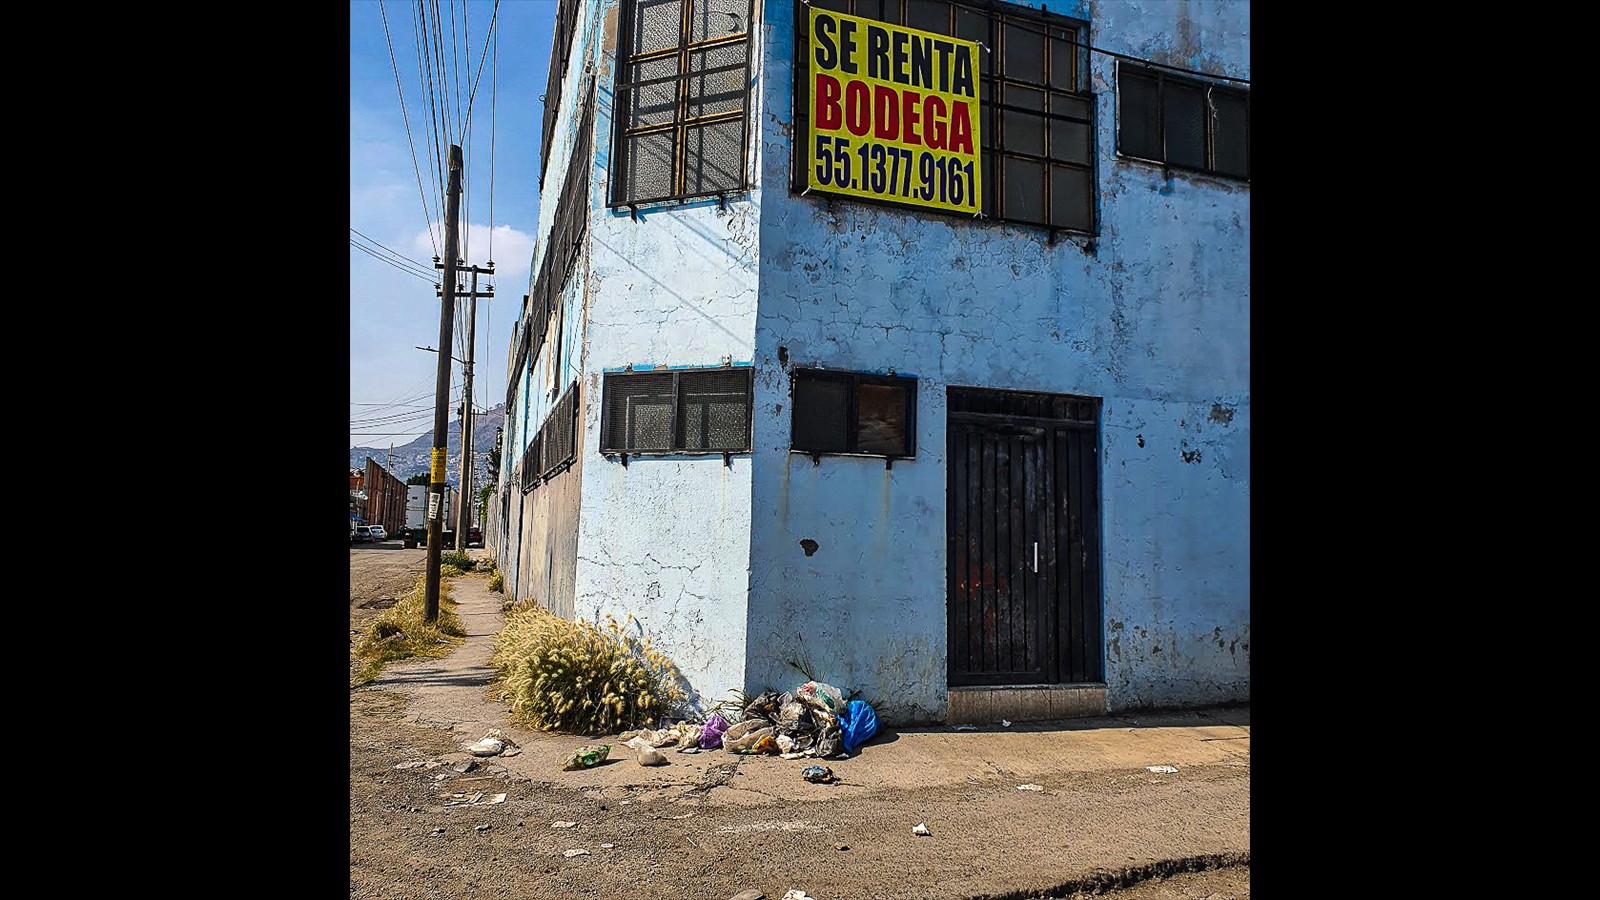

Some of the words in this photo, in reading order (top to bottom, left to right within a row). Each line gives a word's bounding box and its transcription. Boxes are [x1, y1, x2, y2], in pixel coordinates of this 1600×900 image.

[814, 14, 858, 74] SE
[867, 25, 975, 98] RENTA
[815, 73, 974, 156] BODEGA
[815, 135, 975, 206] 55.1377.9161
